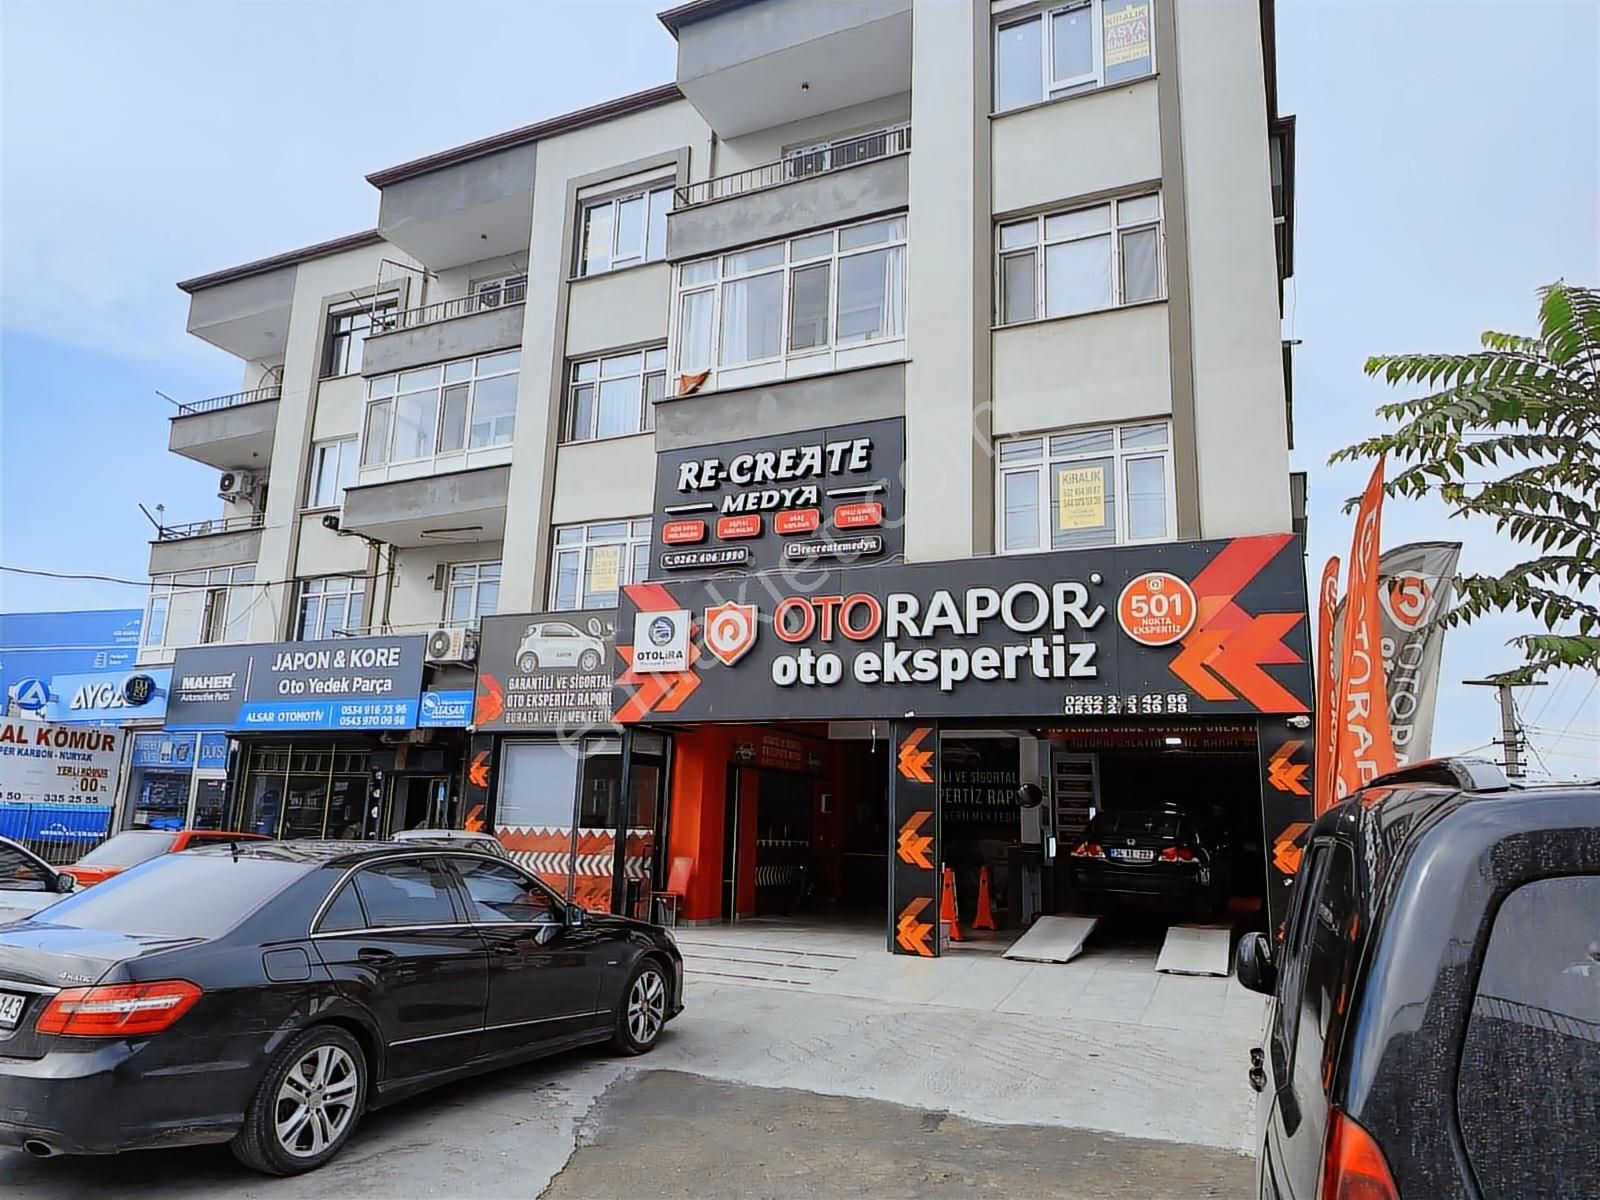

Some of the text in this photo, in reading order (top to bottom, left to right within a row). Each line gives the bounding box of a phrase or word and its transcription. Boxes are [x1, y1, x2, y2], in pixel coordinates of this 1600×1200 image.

[677, 438, 870, 490] RE-CREATE
[720, 485, 818, 514] MEDYA
[1130, 592, 1182, 618] 501
[1142, 617, 1172, 626] NOKTA
[271, 647, 401, 672] JAPON & KORE
[772, 635, 1098, 692] oto ekspertiz
[181, 675, 234, 690] MAHER
[278, 676, 393, 695] Oto Yedek Parça
[508, 673, 613, 691] GARANTİLİ VE SİGORTAL
[506, 692, 525, 708] OTO
[526, 690, 576, 707] EKSPERTİZ
[1065, 695, 1104, 705] 0262
[1142, 693, 1162, 705] 42
[1166, 693, 1188, 704] 66
[246, 708, 325, 723] ALSAR OTOMOTİV
[1064, 704, 1103, 715] 0532
[1142, 703, 1162, 714] 39
[1166, 703, 1188, 714] 58
[36, 726, 116, 752] KÖMÜR
[17, 746, 53, 759] KARBON
[43, 793, 65, 803] 335
[85, 796, 99, 804] 55
